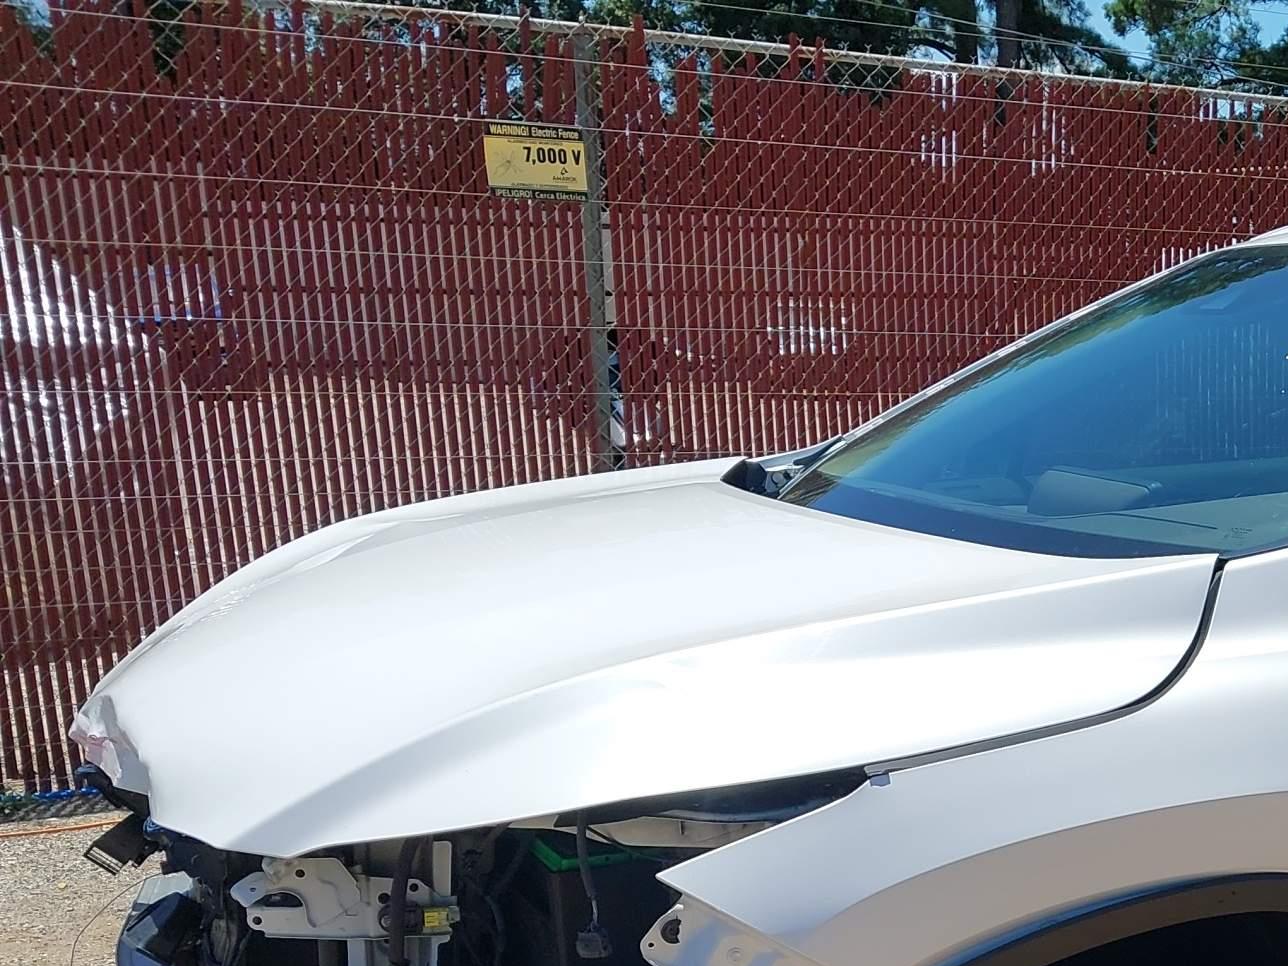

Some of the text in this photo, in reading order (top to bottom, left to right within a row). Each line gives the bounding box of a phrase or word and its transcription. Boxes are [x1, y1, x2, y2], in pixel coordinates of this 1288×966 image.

[488, 123, 579, 139] WARNING! Electric Fence
[523, 146, 582, 166] 7,000 V
[535, 191, 555, 199] Cerca
